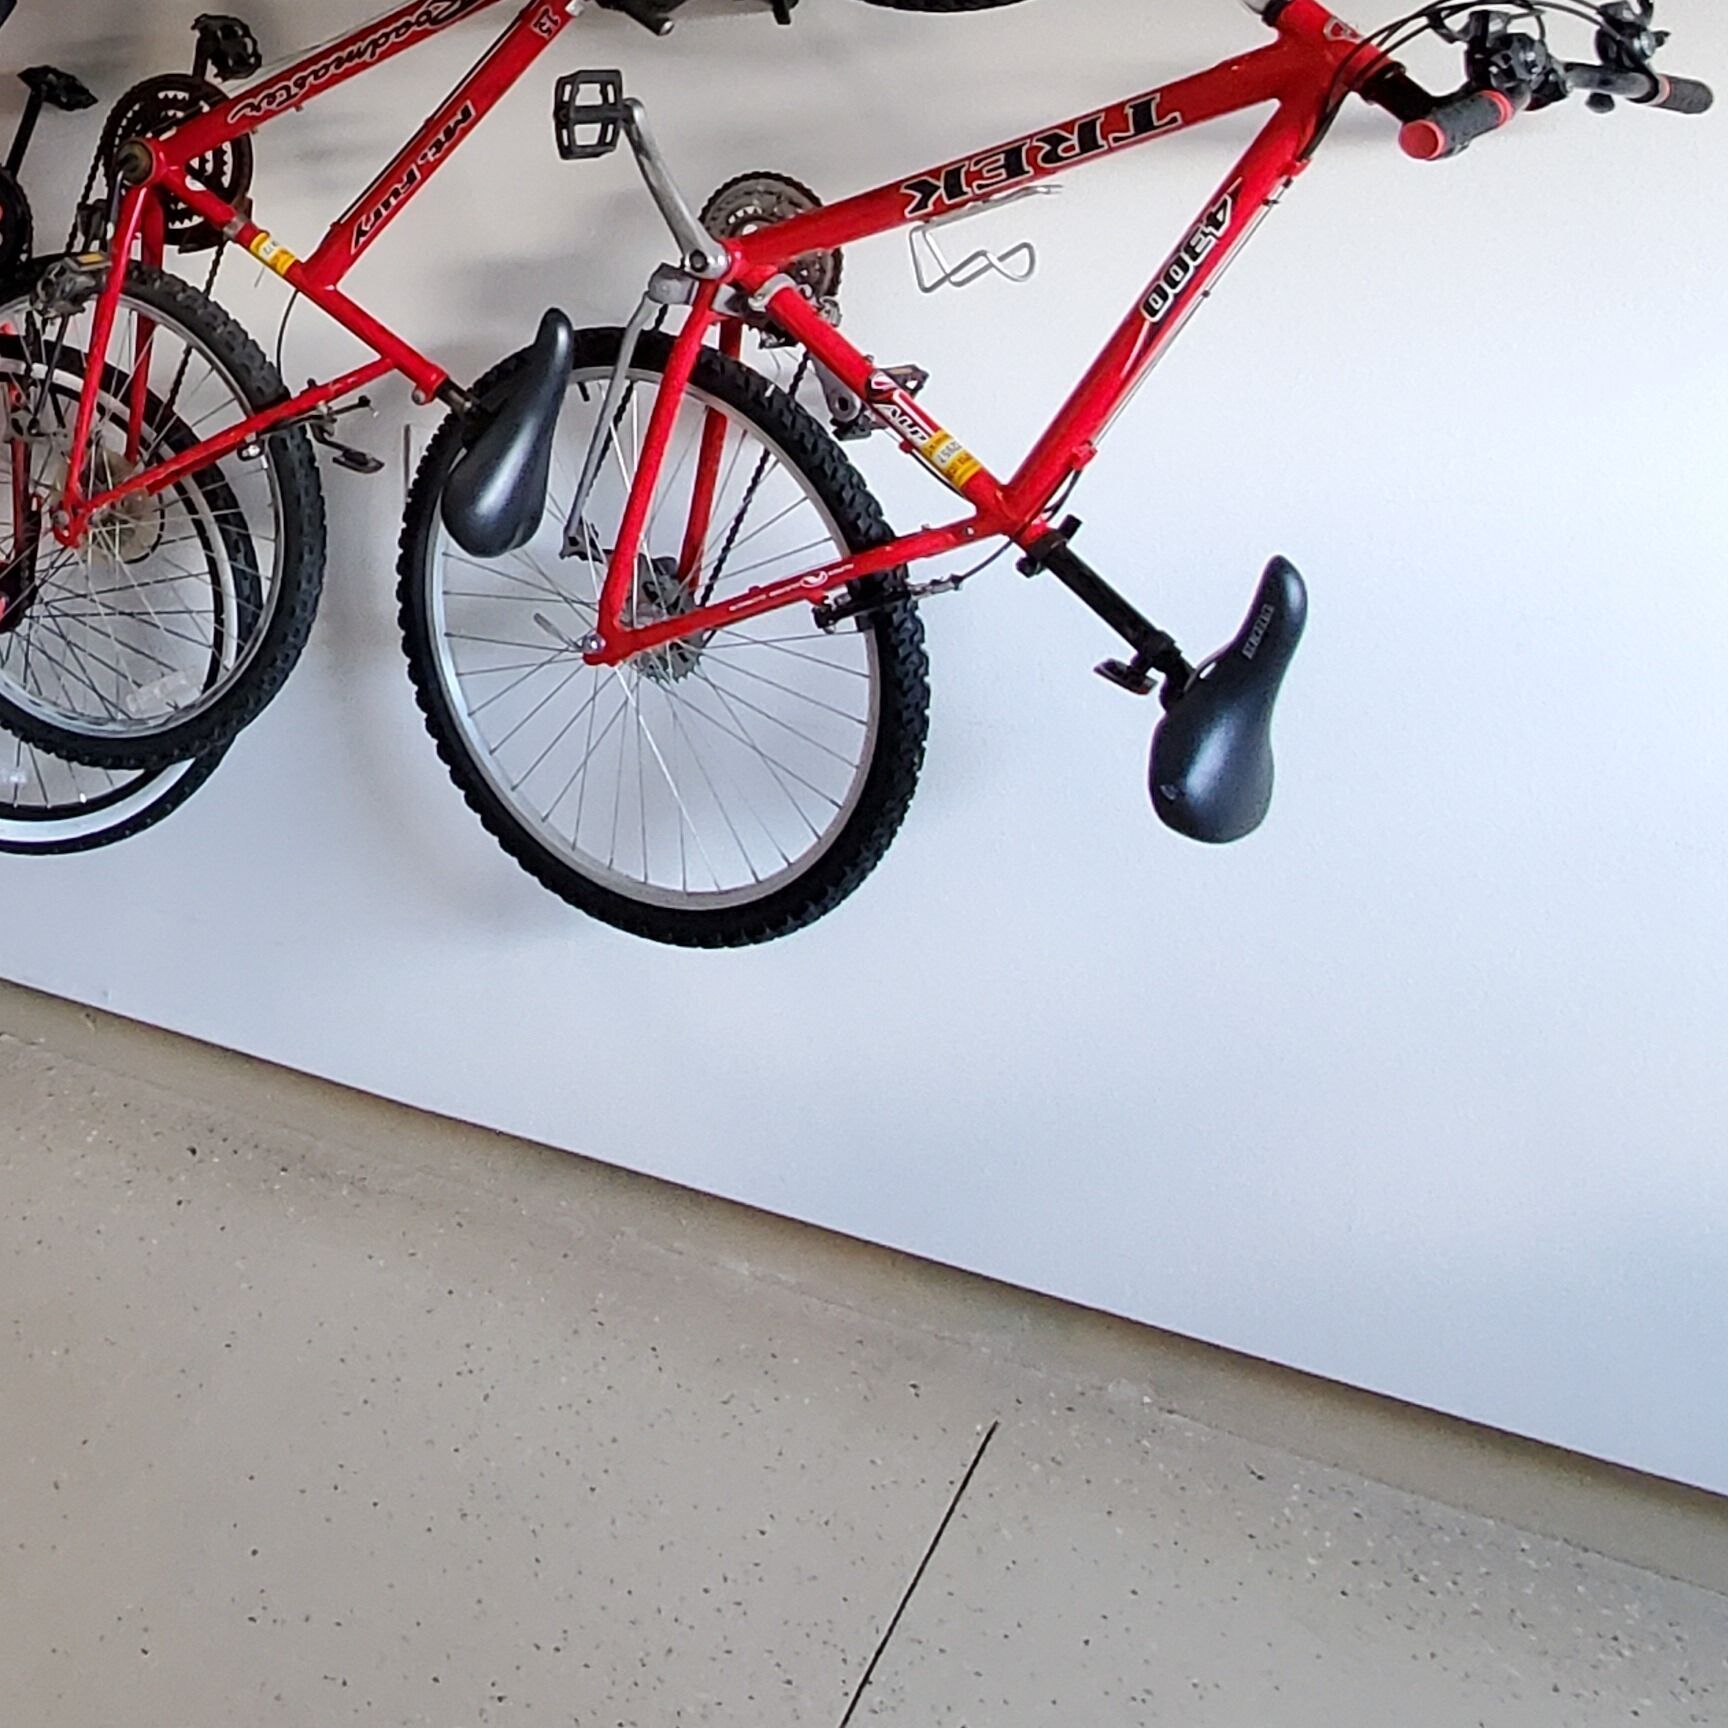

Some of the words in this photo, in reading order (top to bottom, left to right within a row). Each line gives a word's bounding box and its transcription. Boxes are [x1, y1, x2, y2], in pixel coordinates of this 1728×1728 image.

[351, 171, 421, 254] Fury
[900, 94, 1181, 218] TREK
[1141, 178, 1243, 324] 4300
